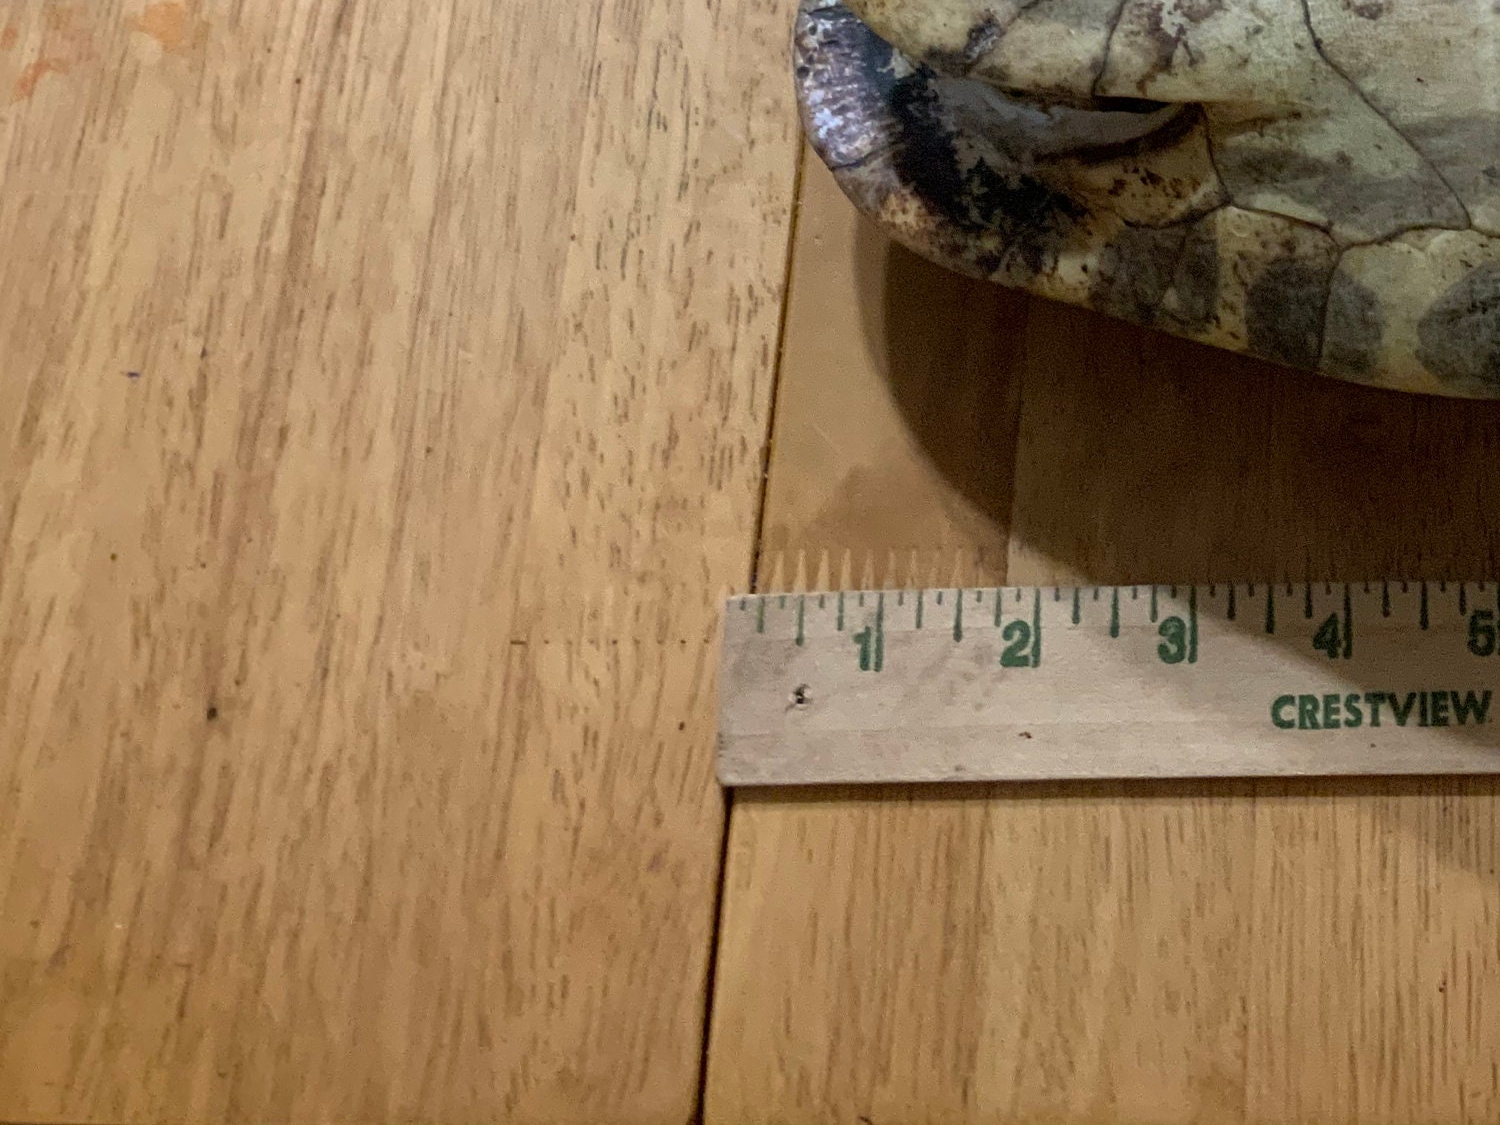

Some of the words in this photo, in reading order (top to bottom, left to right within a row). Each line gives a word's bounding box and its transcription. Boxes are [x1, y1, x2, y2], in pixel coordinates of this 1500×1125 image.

[1000, 620, 1032, 668] 2
[1157, 616, 1187, 664] 3
[1312, 613, 1341, 658] 4
[1467, 609, 1496, 657] 5
[1270, 688, 1493, 730] CRESTVIEW
